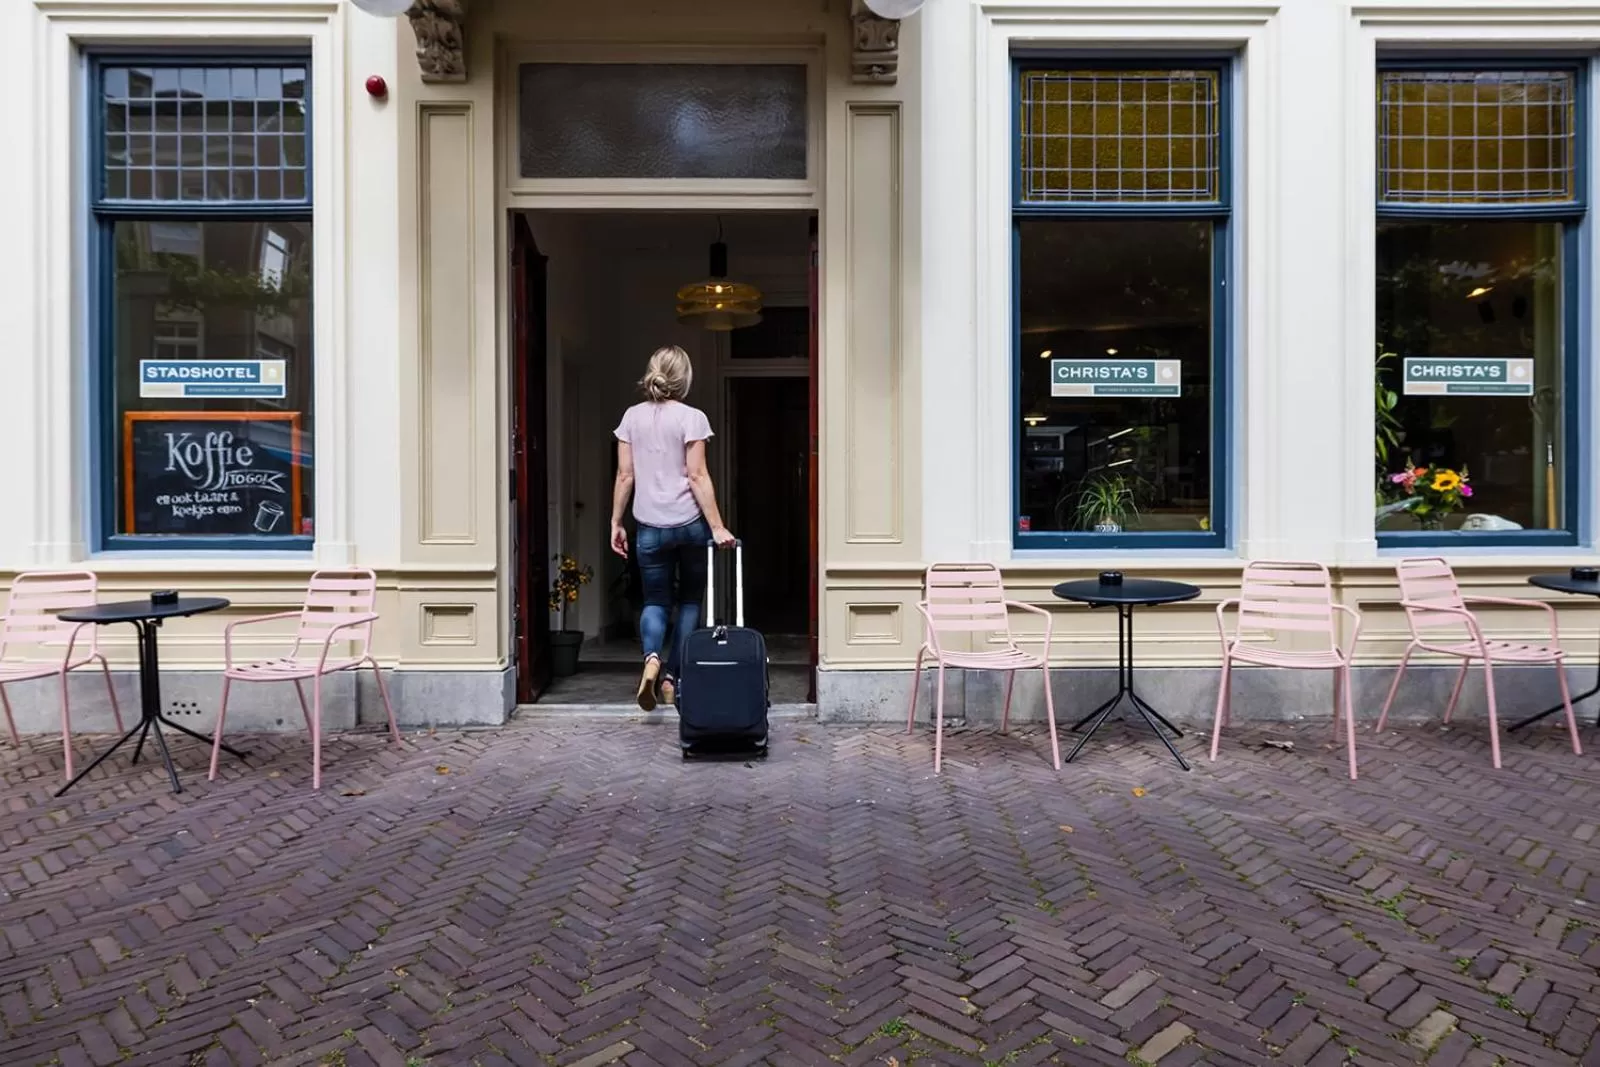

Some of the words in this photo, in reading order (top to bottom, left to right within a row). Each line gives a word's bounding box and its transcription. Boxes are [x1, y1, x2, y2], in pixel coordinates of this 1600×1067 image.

[146, 366, 256, 378] STADSHOTEL
[1058, 366, 1148, 378] CHRISTA'S
[1410, 365, 1501, 377] CHRISTA'S
[164, 430, 253, 491] Koffie
[171, 492, 193, 504] ook
[193, 491, 228, 503] taart
